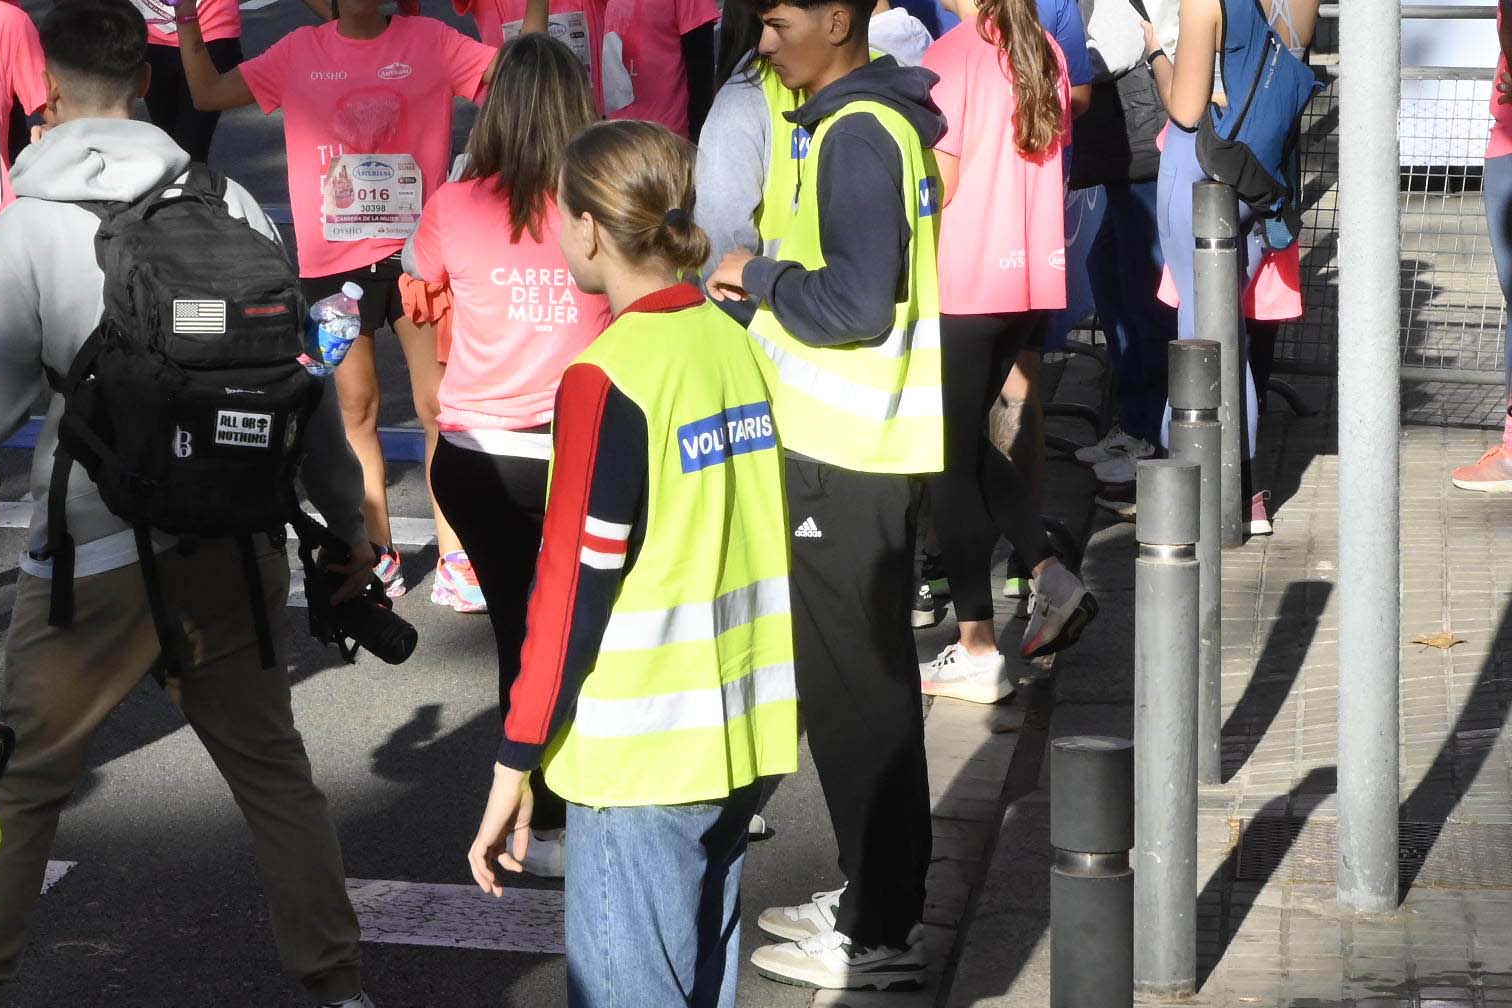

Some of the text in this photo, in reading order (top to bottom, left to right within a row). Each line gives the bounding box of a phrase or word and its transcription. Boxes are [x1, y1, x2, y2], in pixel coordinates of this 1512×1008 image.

[310, 70, 348, 80] OYSHO
[357, 188, 390, 201] 016
[360, 204, 386, 212] 30398
[512, 286, 575, 305] DE LA
[507, 305, 579, 324] MUJER
[219, 415, 257, 429] ALL OR
[217, 430, 268, 444] NOTHING
[794, 528, 822, 538] adidas
